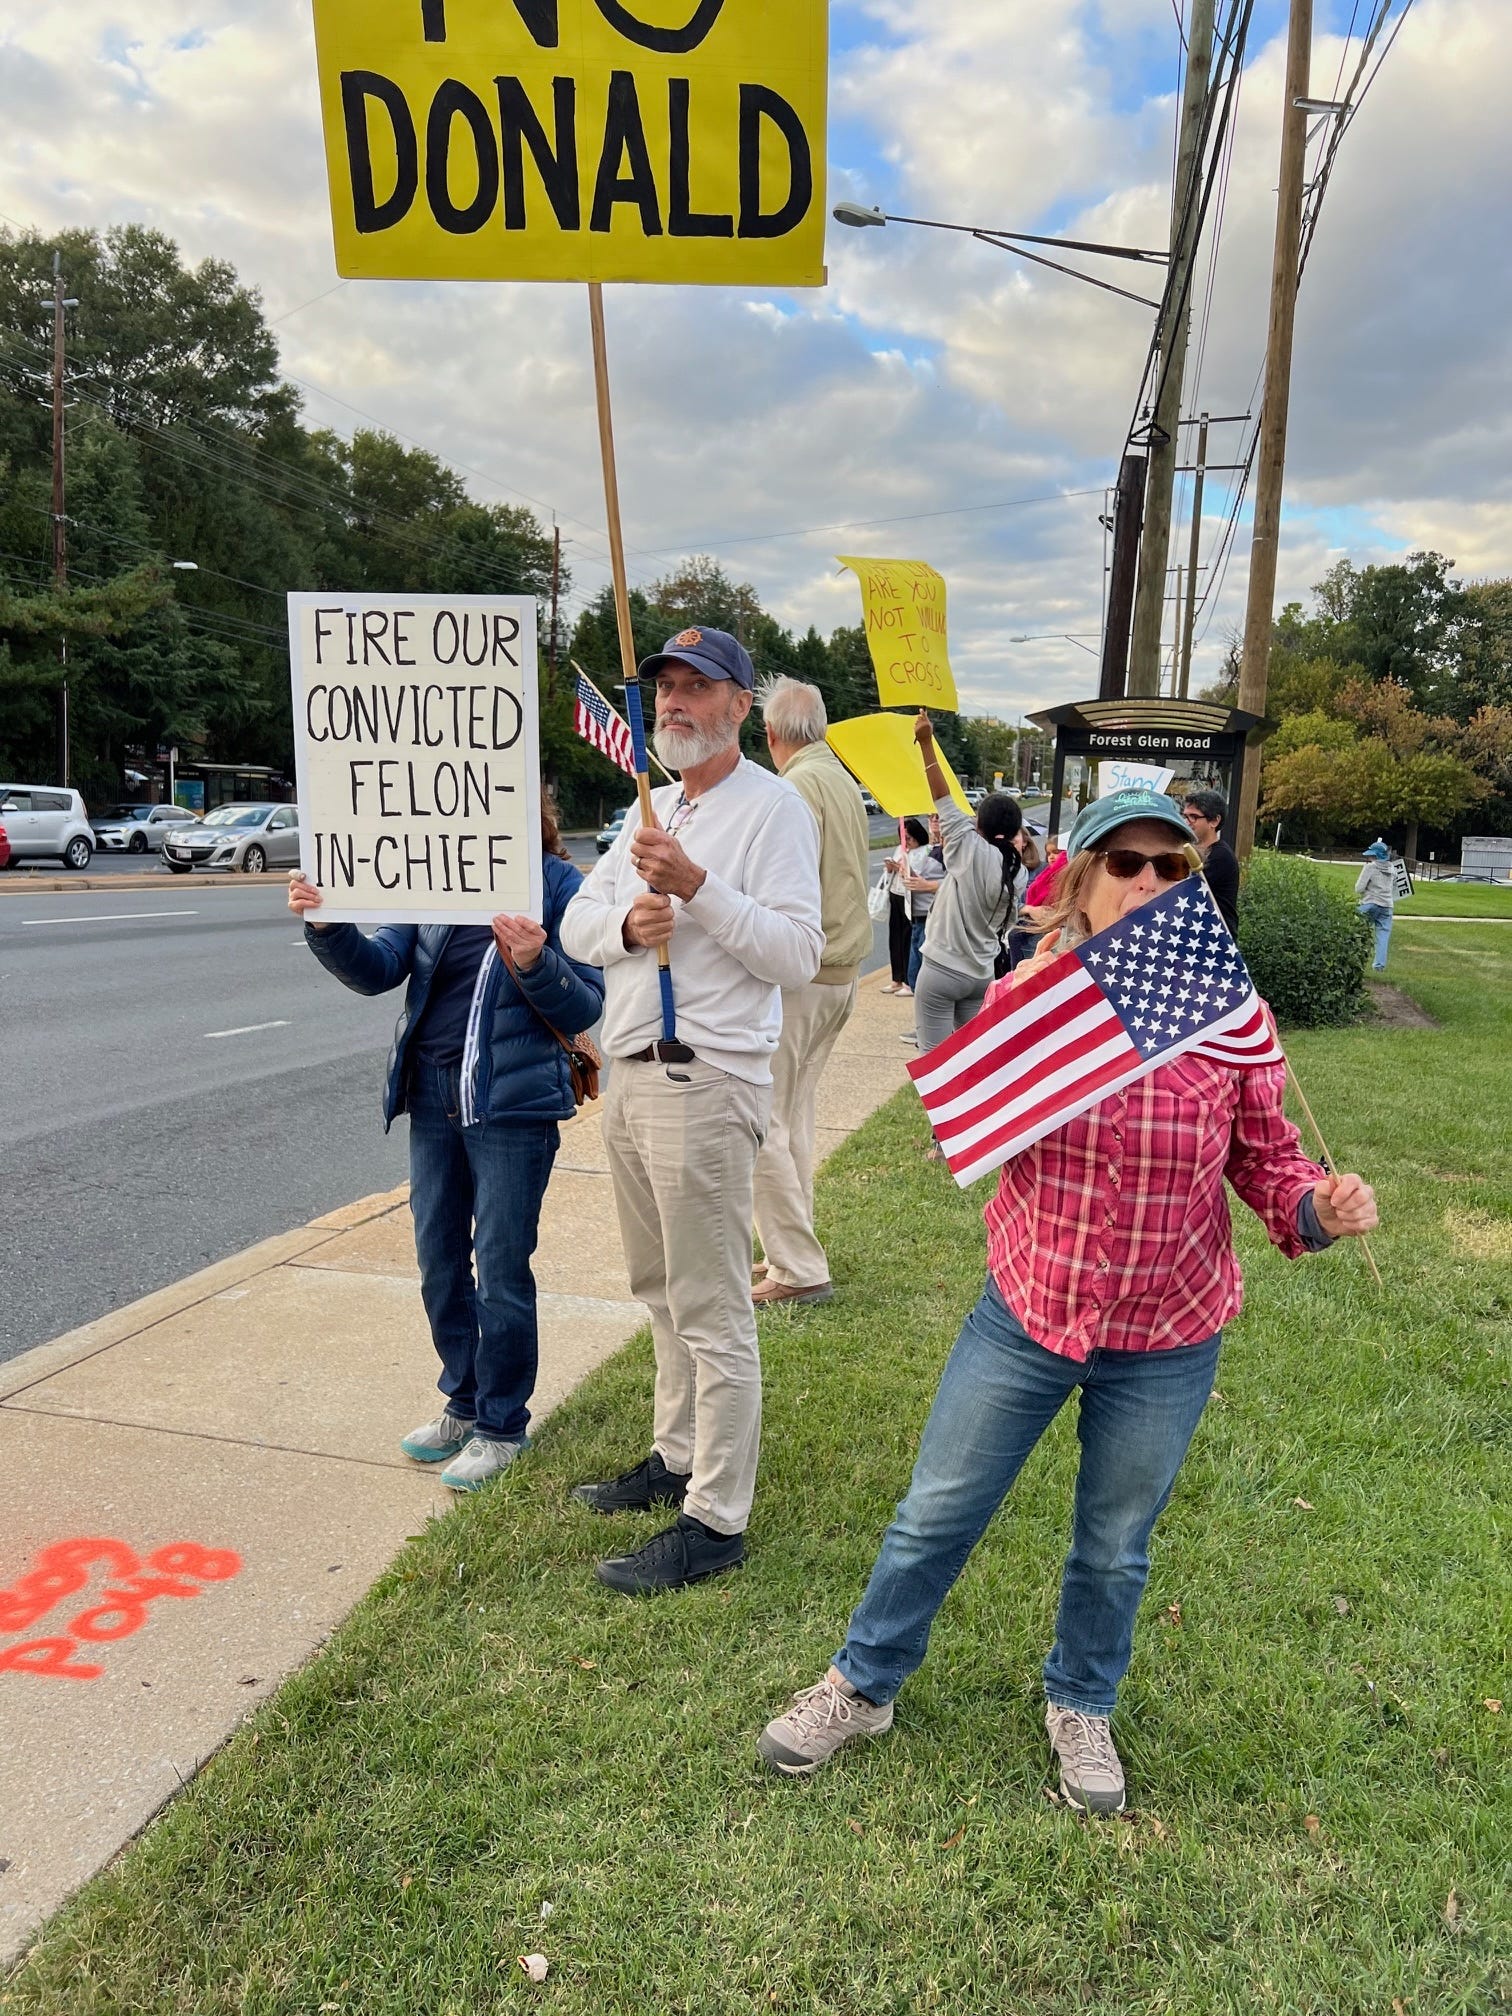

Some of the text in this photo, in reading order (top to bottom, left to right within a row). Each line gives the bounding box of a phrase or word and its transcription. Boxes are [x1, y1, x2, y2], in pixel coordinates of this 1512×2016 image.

[340, 70, 812, 238] DONALD
[868, 575, 936, 602] ARE YOU
[869, 606, 905, 632] NOT
[315, 608, 520, 667] FIRE OUR
[898, 633, 930, 653] TO
[890, 661, 942, 691] CROSS
[306, 684, 523, 750] CONVICTED
[1089, 734, 1211, 748] Forest Glen Road
[349, 760, 515, 817] FELON-
[1107, 765, 1164, 791] Stand
[314, 833, 513, 892] IN-CHIEF
